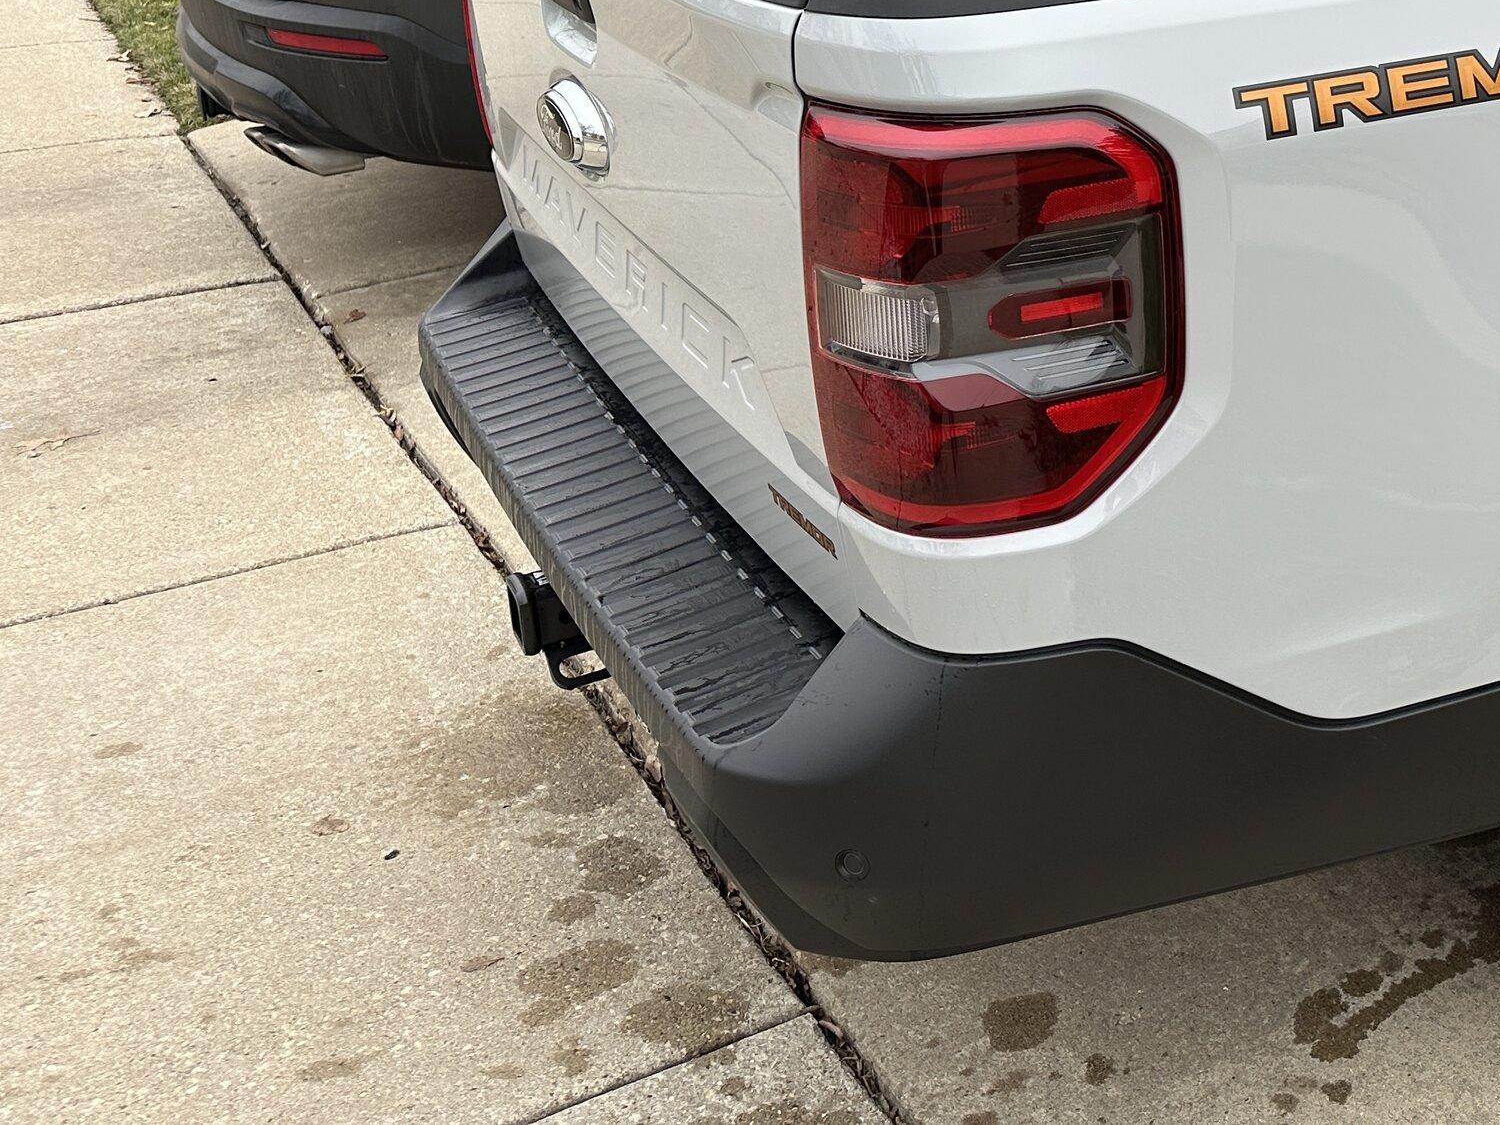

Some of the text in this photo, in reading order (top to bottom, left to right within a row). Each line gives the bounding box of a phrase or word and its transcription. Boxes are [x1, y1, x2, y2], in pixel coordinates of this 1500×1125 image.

[540, 103, 563, 151] Ford
[519, 142, 756, 411] MAVERICK
[767, 483, 838, 560] TREMOR
